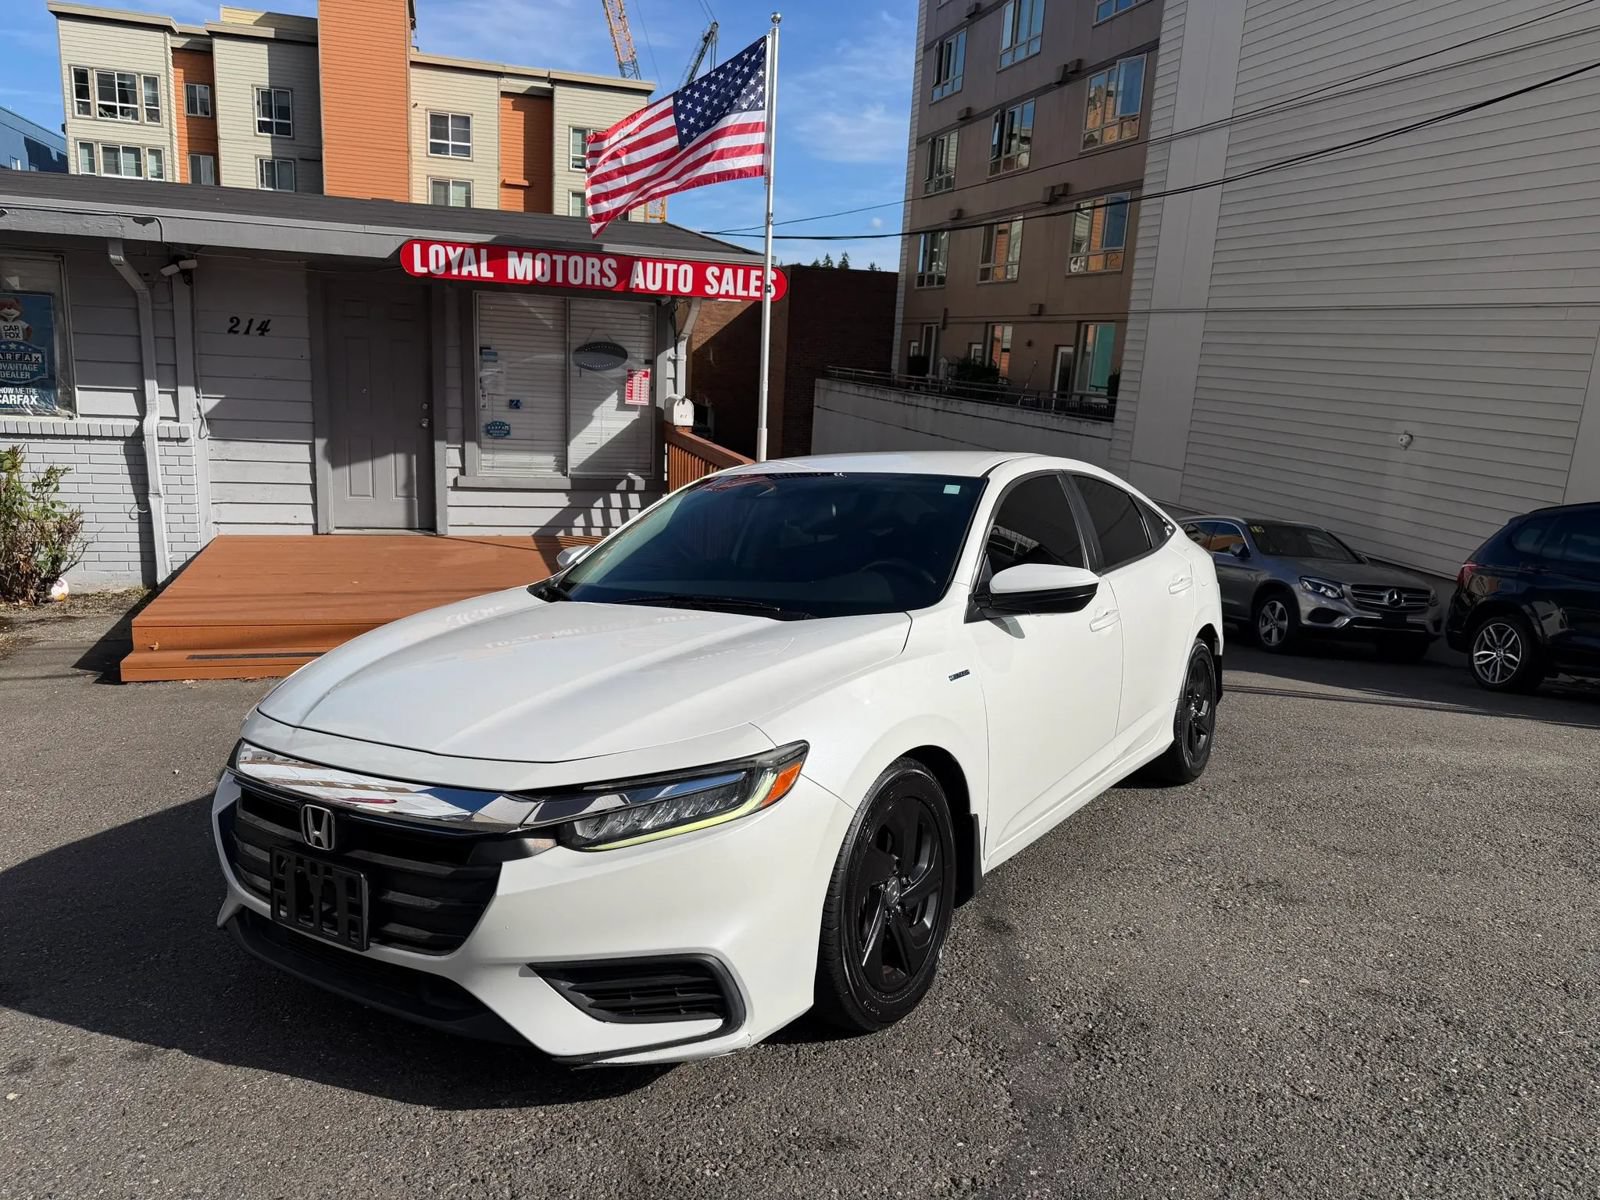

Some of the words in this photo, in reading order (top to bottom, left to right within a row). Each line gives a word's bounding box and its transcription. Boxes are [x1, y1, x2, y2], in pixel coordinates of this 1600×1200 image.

[413, 243, 494, 278] LOYAL
[507, 250, 617, 288] MOTORS
[629, 260, 694, 293] AUTO
[704, 266, 777, 299] SALES
[227, 316, 271, 336] 214
[4, 331, 21, 339] FOX
[0, 353, 41, 362] ARFAX
[0, 370, 31, 379] DEALER
[15, 387, 25, 395] ME
